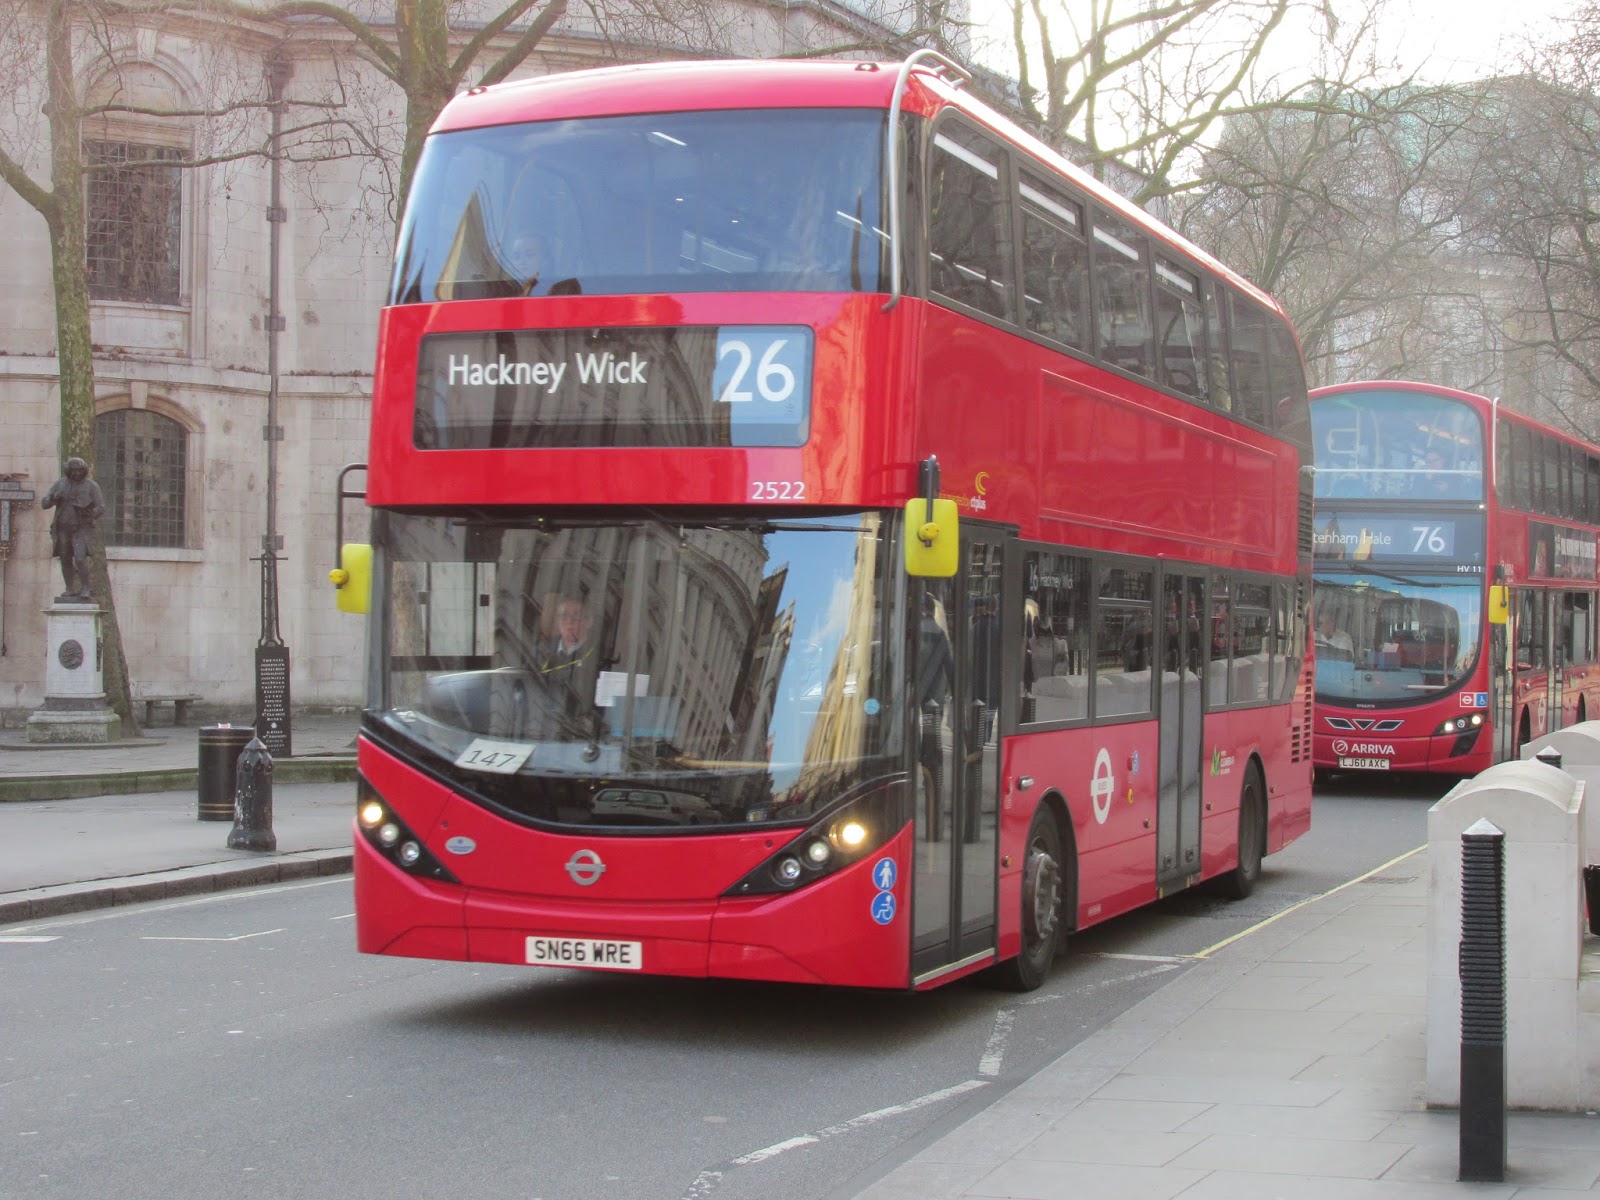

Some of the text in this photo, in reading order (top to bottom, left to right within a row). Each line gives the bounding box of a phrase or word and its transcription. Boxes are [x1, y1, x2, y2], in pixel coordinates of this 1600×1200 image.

[448, 351, 648, 394] Hackney Wick
[719, 339, 796, 402] 26
[751, 481, 806, 500] 2522
[1363, 531, 1392, 545] Hale
[1412, 526, 1446, 553] 76
[1457, 565, 1470, 573] HV
[1351, 743, 1396, 755] ARRIVA
[464, 750, 517, 768] 147
[1342, 757, 1386, 768] LJ60 AXC
[535, 940, 631, 964] SN66 WRE
